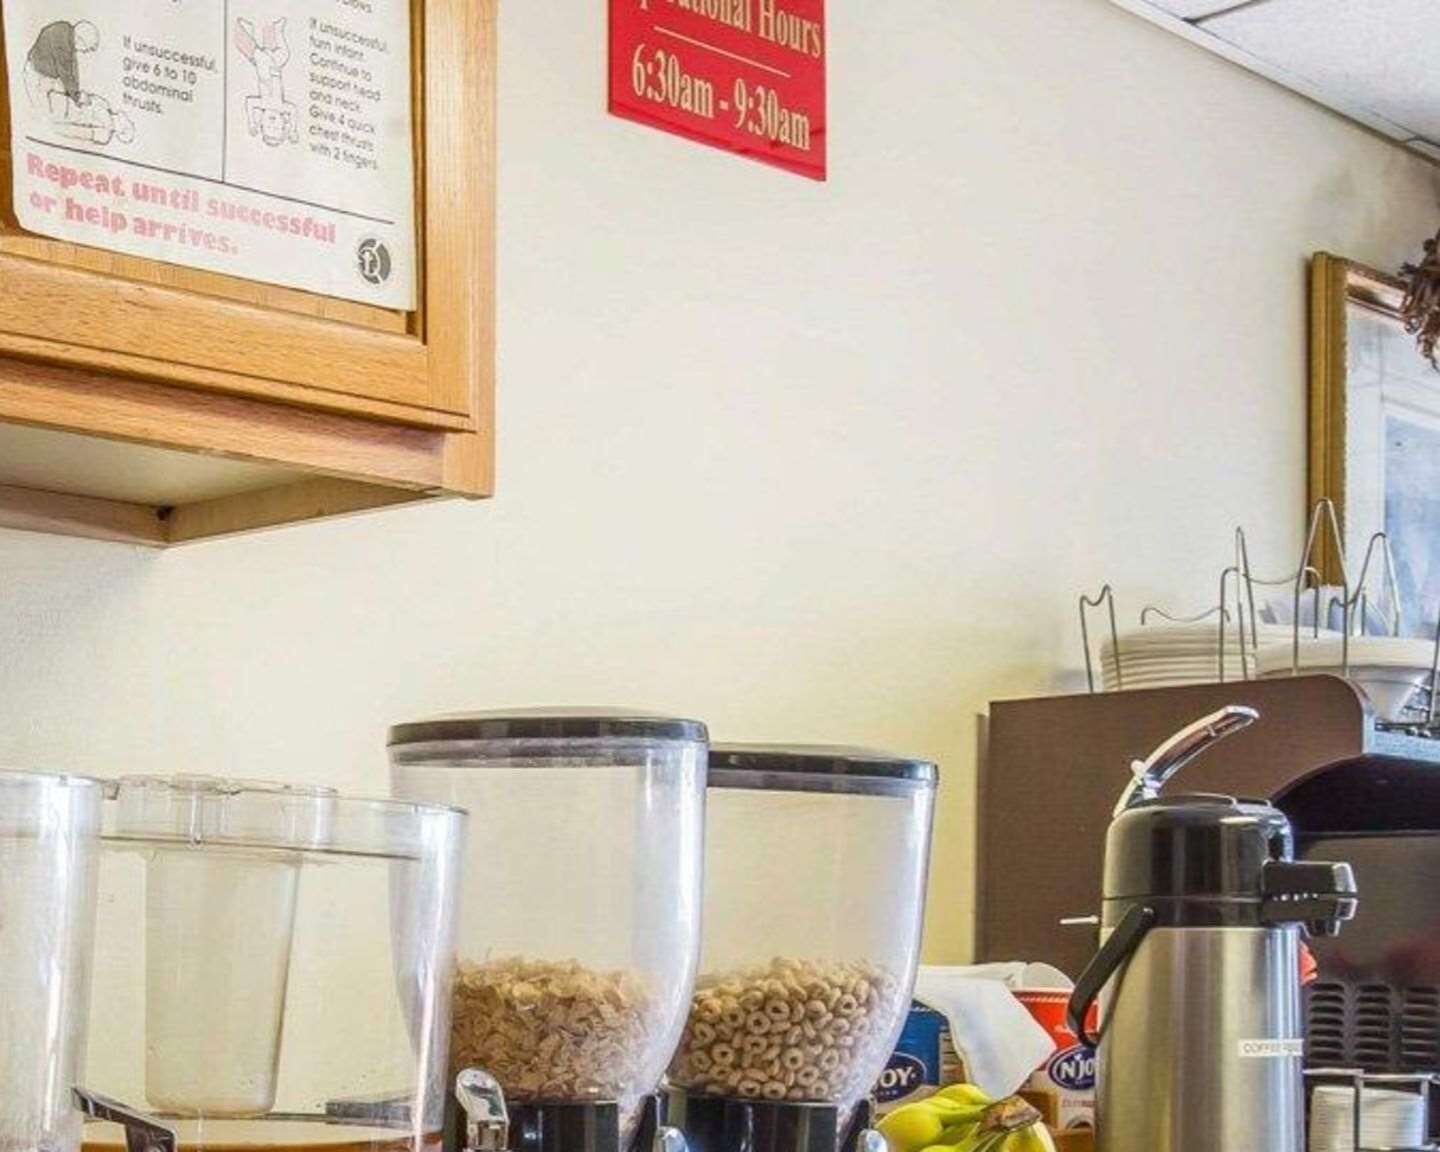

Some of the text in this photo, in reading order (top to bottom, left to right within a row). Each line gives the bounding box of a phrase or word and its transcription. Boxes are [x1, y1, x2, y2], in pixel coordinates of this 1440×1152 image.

[759, 0, 821, 58] Hours
[122, 57, 197, 85] give 6 to 10
[309, 52, 359, 77] Continue
[122, 76, 193, 102] abdominal
[309, 72, 351, 91] support
[309, 90, 332, 105] and
[632, 44, 714, 118] 6:30am
[734, 78, 810, 150] 9:30am
[309, 104, 335, 122] Give
[26, 152, 337, 244] Repeat until successful
[29, 191, 239, 256] or help arrives.
